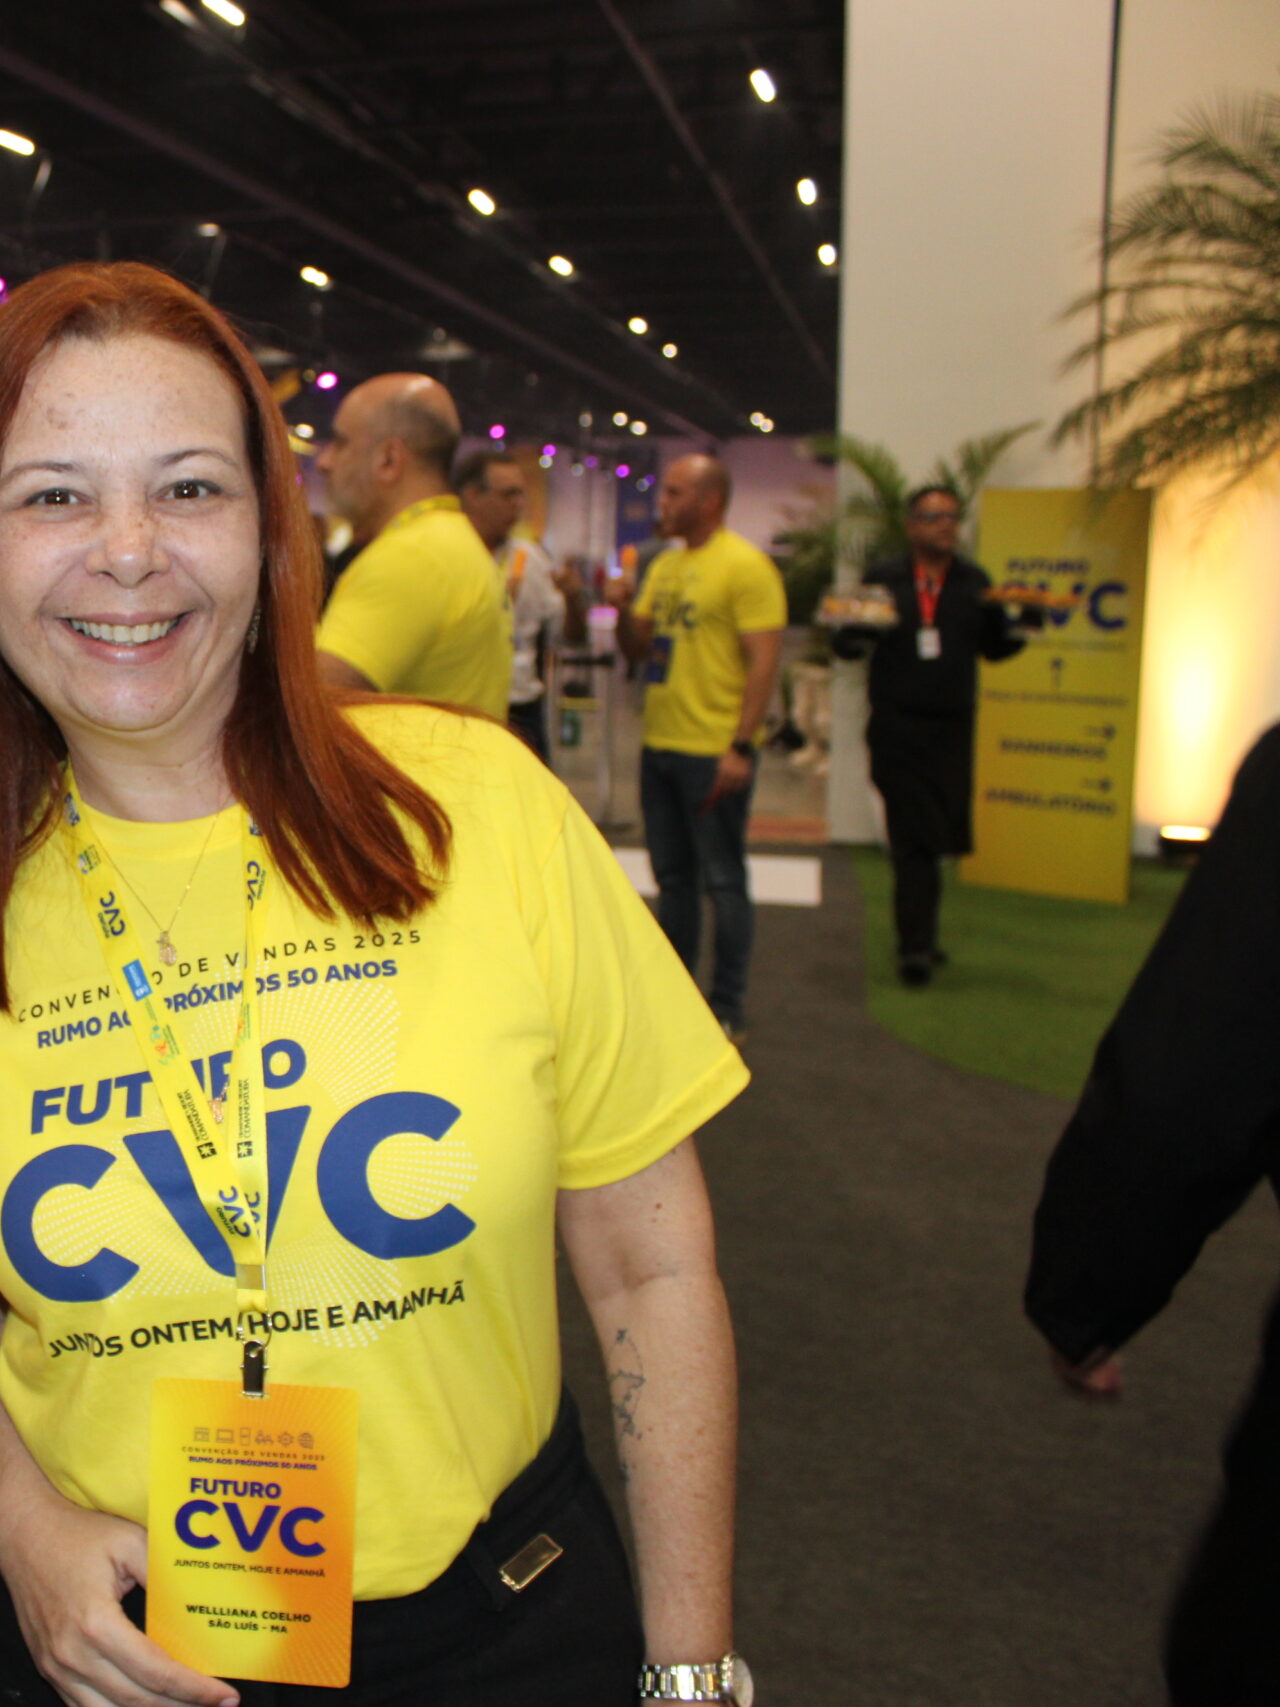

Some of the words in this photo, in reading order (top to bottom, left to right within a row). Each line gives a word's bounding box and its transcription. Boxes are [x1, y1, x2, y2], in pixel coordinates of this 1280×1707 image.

[100, 891, 127, 937] CVC
[18, 971, 163, 1023] CONVENO
[178, 957, 209, 978] DE
[225, 937, 336, 967] VNDAS
[354, 930, 421, 949] 2025
[36, 1016, 102, 1050] RUMO
[287, 967, 318, 988] 50
[325, 959, 398, 983] ANOS
[0, 1090, 477, 1303] CVC
[218, 1185, 252, 1238] CVC
[248, 1308, 319, 1336] HOJE
[328, 1306, 344, 1328] E
[352, 1279, 466, 1325] AMANHÃ
[189, 1456, 214, 1464] RUMO
[235, 1458, 279, 1468] PRÓXIMOS
[281, 1461, 292, 1469] 50
[294, 1463, 318, 1471] ANOS
[190, 1477, 282, 1499] FUTURO
[175, 1499, 327, 1558] CVC
[174, 1559, 210, 1569] JUNTOS
[250, 1565, 273, 1575] HOJE
[284, 1567, 326, 1578] AMANHÃ
[186, 1604, 257, 1618] WELLLIANA
[261, 1610, 312, 1623] COELHO
[208, 1618, 231, 1629] SÃO
[234, 1621, 259, 1631] LUÍS
[270, 1624, 288, 1633] MA
